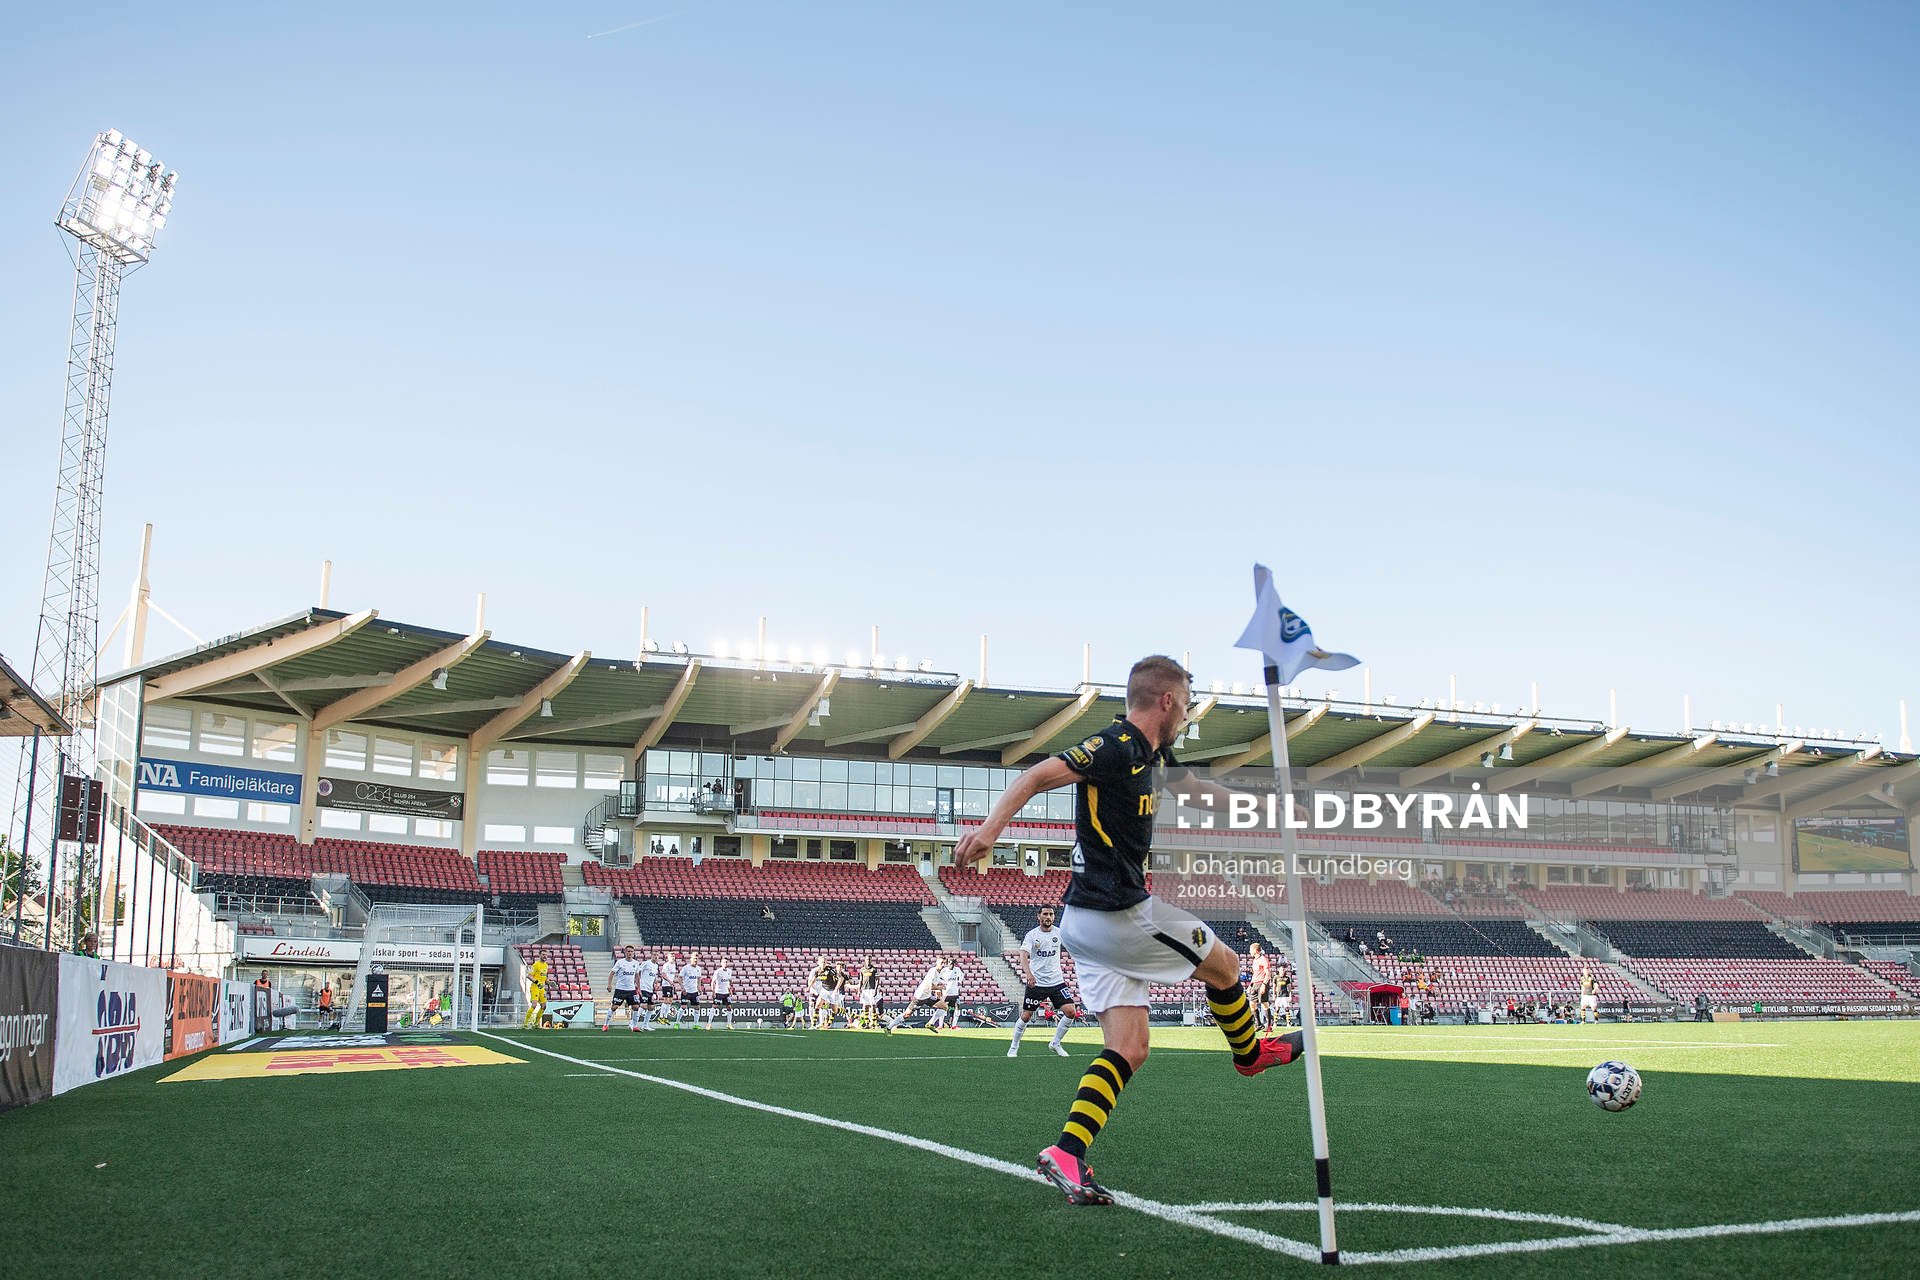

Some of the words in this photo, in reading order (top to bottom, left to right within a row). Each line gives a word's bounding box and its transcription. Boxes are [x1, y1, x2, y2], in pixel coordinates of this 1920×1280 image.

[138, 762, 181, 787] NA
[189, 771, 295, 795] Familjeläktare
[271, 942, 331, 957] Lindells
[398, 949, 418, 958] sport
[429, 950, 452, 958] sedan
[459, 951, 474, 959] 914
[722, 1007, 781, 1017] SORTKLUBB
[1729, 1005, 1752, 1014] ÖREBRO
[1753, 1005, 1788, 1013] RTKLUBB
[1792, 1005, 1821, 1014] STOLTHET,
[1821, 1004, 1841, 1014] HJÄRTA
[1869, 1004, 1886, 1012] SEDAN
[1886, 1004, 1901, 1012] 1908
